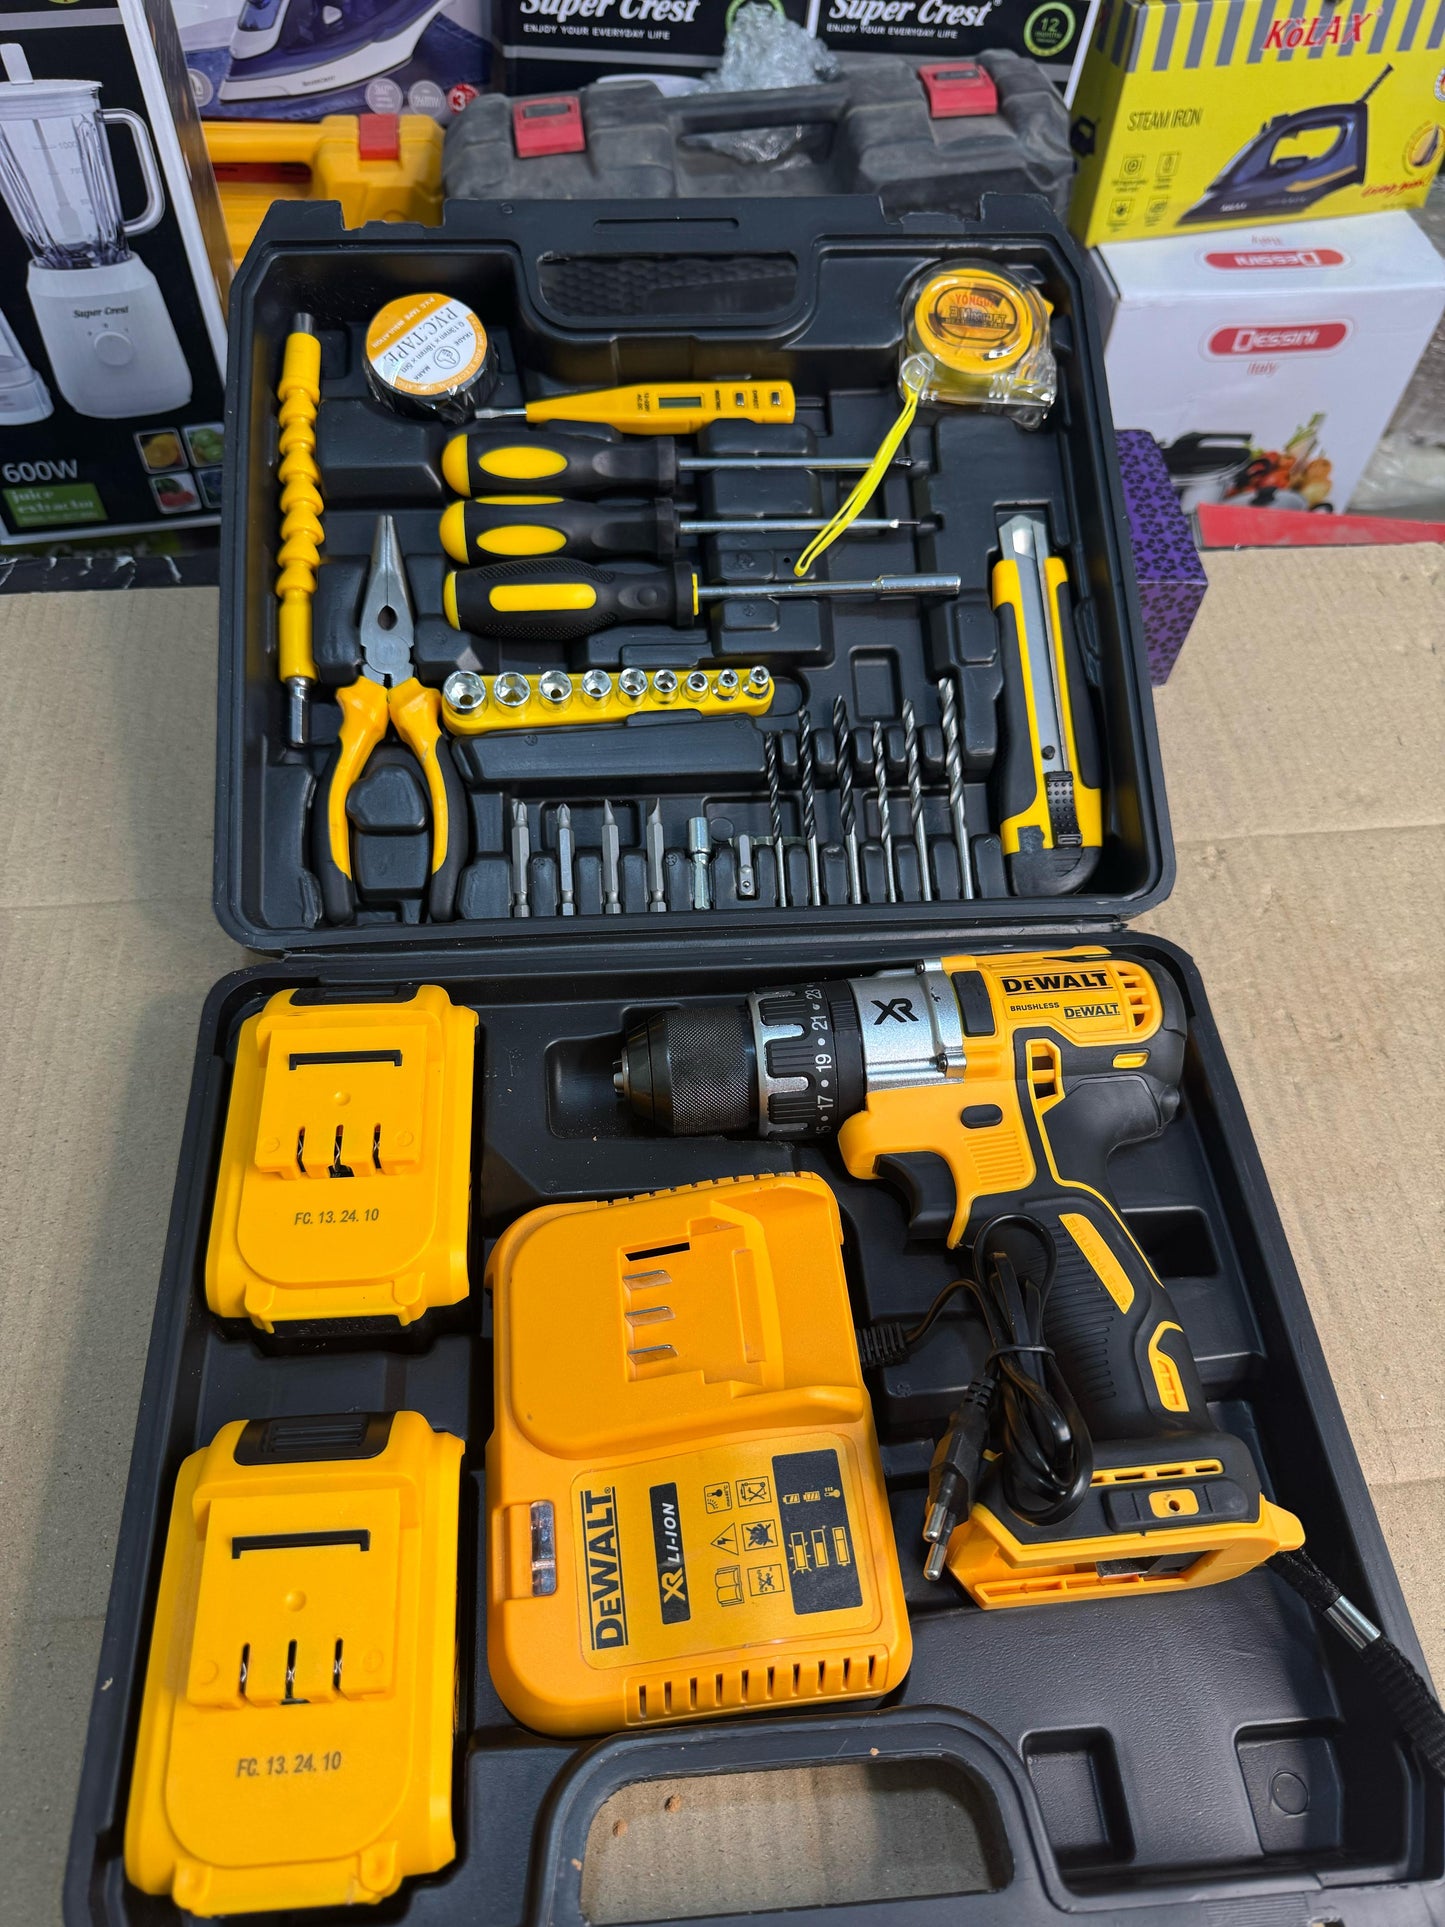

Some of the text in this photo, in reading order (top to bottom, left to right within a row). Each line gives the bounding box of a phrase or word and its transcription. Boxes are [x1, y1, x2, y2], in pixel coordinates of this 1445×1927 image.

[520, 0, 701, 23] Super Crest
[829, 0, 992, 27] Super Crest
[523, 23, 671, 40] ENJOY YOUR EVERYDAY LIFE
[826, 23, 959, 39] ENJOY YOUR EVERYDAY LIFE
[1041, 17, 1061, 32] 12
[1127, 107, 1204, 131] STEAM IRON
[73, 305, 130, 319] Super Crest
[454, 331, 474, 347] TRADE
[414, 365, 431, 381] MARK
[2, 459, 79, 484] 600W
[870, 998, 919, 1026] XR
[1009, 1002, 1060, 1012] BRUSHLESS
[812, 1014, 828, 1031] 21
[815, 1053, 833, 1073] 19
[818, 1095, 834, 1111] 17
[318, 1211, 337, 1225] 13.
[340, 1209, 360, 1224] 24.
[365, 1208, 380, 1222] 10
[660, 1502, 686, 1602] XR LI-ION
[267, 1755, 288, 1776] 13.
[293, 1753, 317, 1775] 24.
[323, 1751, 342, 1771] 10
